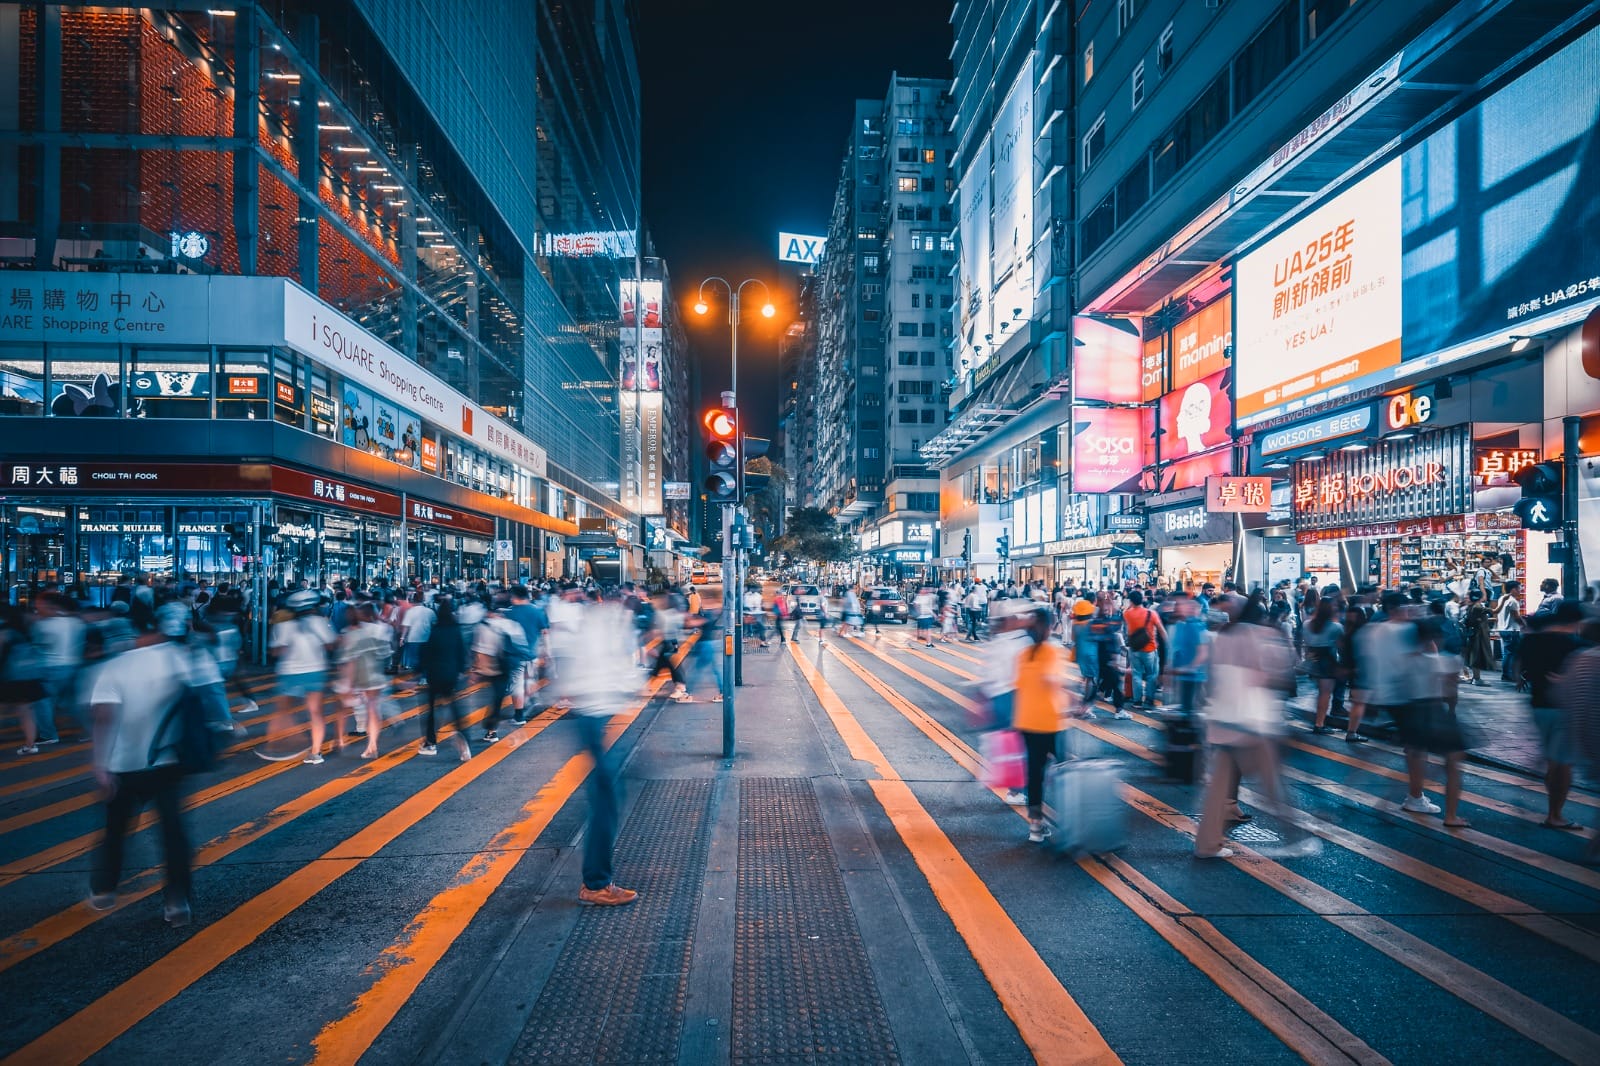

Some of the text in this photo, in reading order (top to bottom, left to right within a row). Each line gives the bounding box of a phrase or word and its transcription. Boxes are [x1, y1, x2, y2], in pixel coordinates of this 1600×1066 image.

[786, 238, 822, 261] AX
[1274, 219, 1355, 287] UA25年
[1273, 254, 1352, 320] 創新領前
[10, 288, 165, 313] 場購物中心
[43, 316, 109, 335] Shopping
[114, 318, 165, 332] Centre
[1284, 317, 1335, 350] YES UA!
[323, 325, 375, 374] SQUARE
[379, 361, 417, 402] Shopping
[419, 385, 444, 413] Centre
[1268, 407, 1319, 427] NETWORK
[1389, 393, 1430, 429] Cke
[648, 409, 656, 452] EMPEROR
[1267, 413, 1360, 448] watsons 屈臣氏
[12, 466, 157, 485] 周大福 CHOW TAI FOOK
[1296, 473, 1345, 510] 卓悅
[1349, 461, 1444, 495] BONJOUR
[314, 479, 345, 501] 周大福
[1219, 483, 1265, 506] 卓悅
[80, 524, 162, 532] FRANCK MULLER
[179, 525, 217, 533] FRANCK
[1406, 522, 1428, 534] SALE
